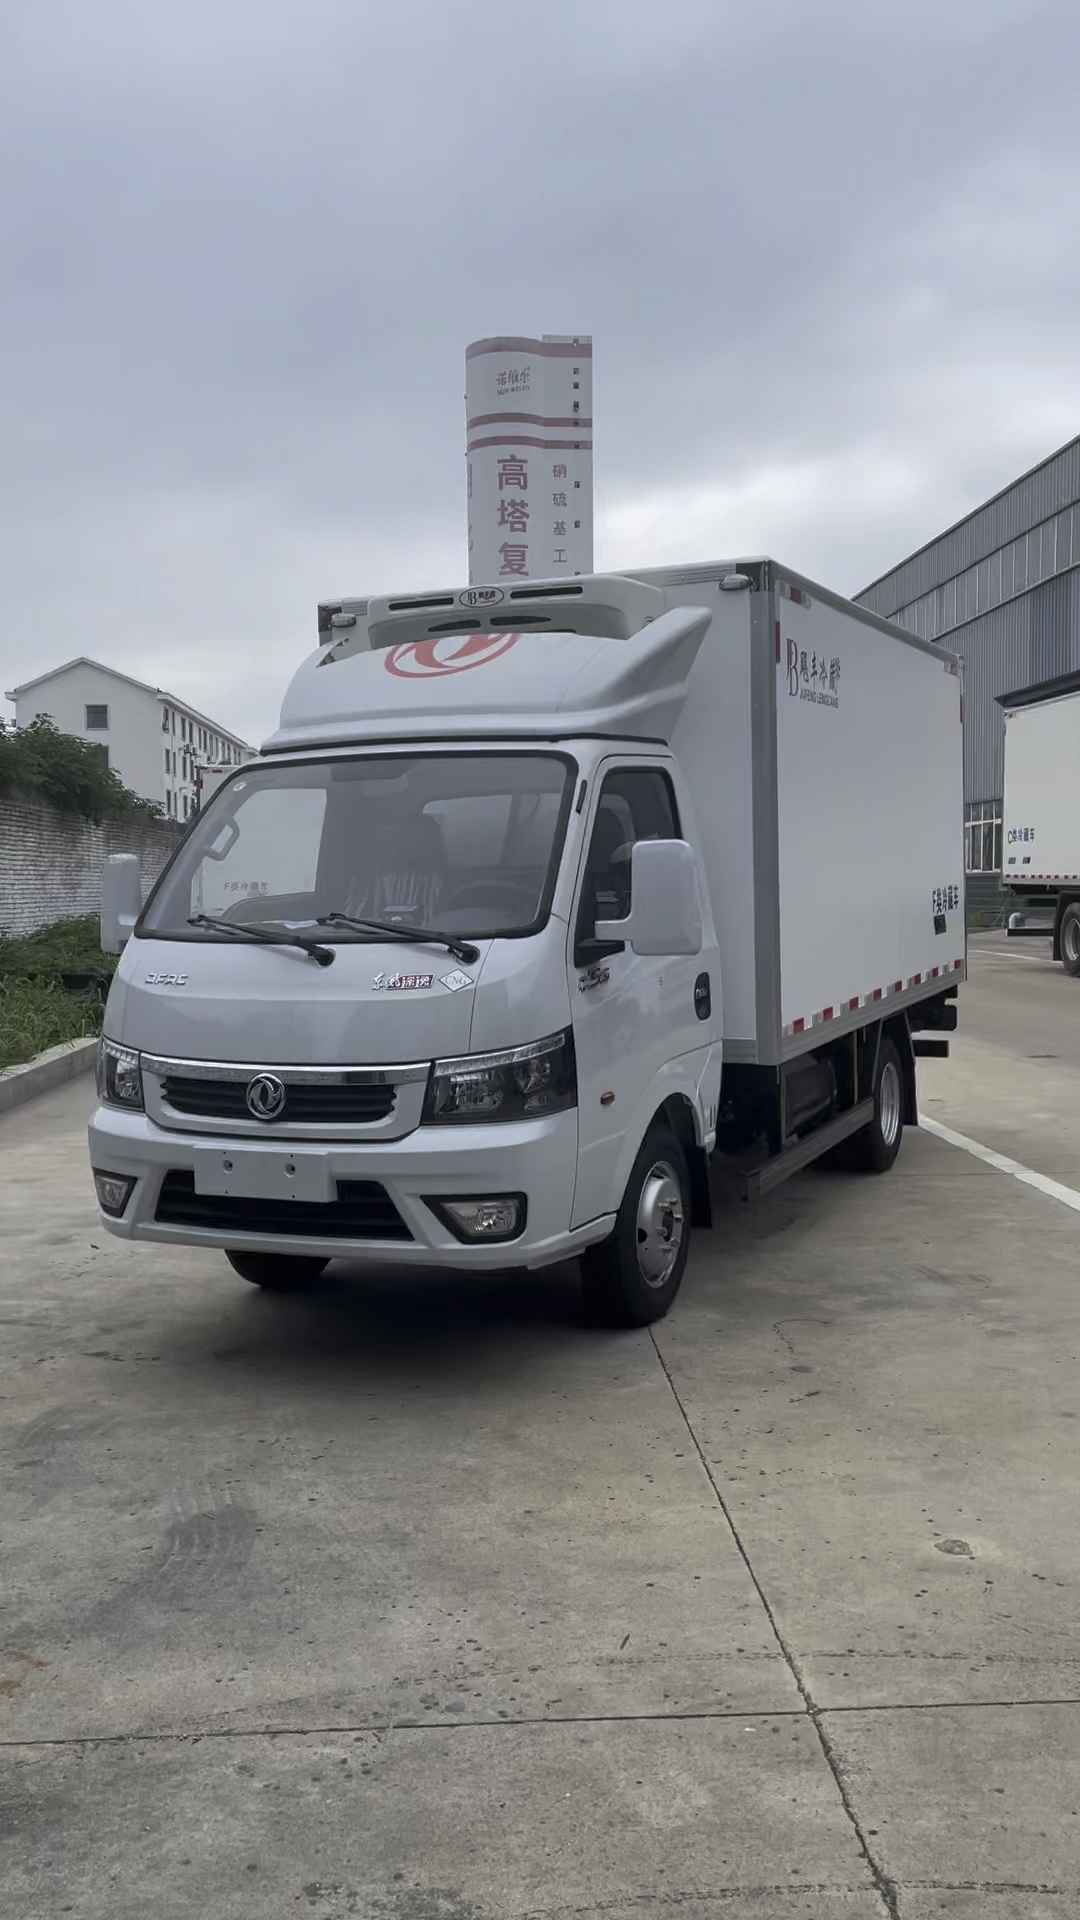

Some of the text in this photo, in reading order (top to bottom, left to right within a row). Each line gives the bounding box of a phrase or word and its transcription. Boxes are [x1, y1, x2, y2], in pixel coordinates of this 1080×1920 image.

[496, 367, 531, 386] 诺维尔
[496, 454, 530, 577] 高塔复
[933, 884, 959, 914] F类冷藏车
[445, 975, 467, 986] CNG
